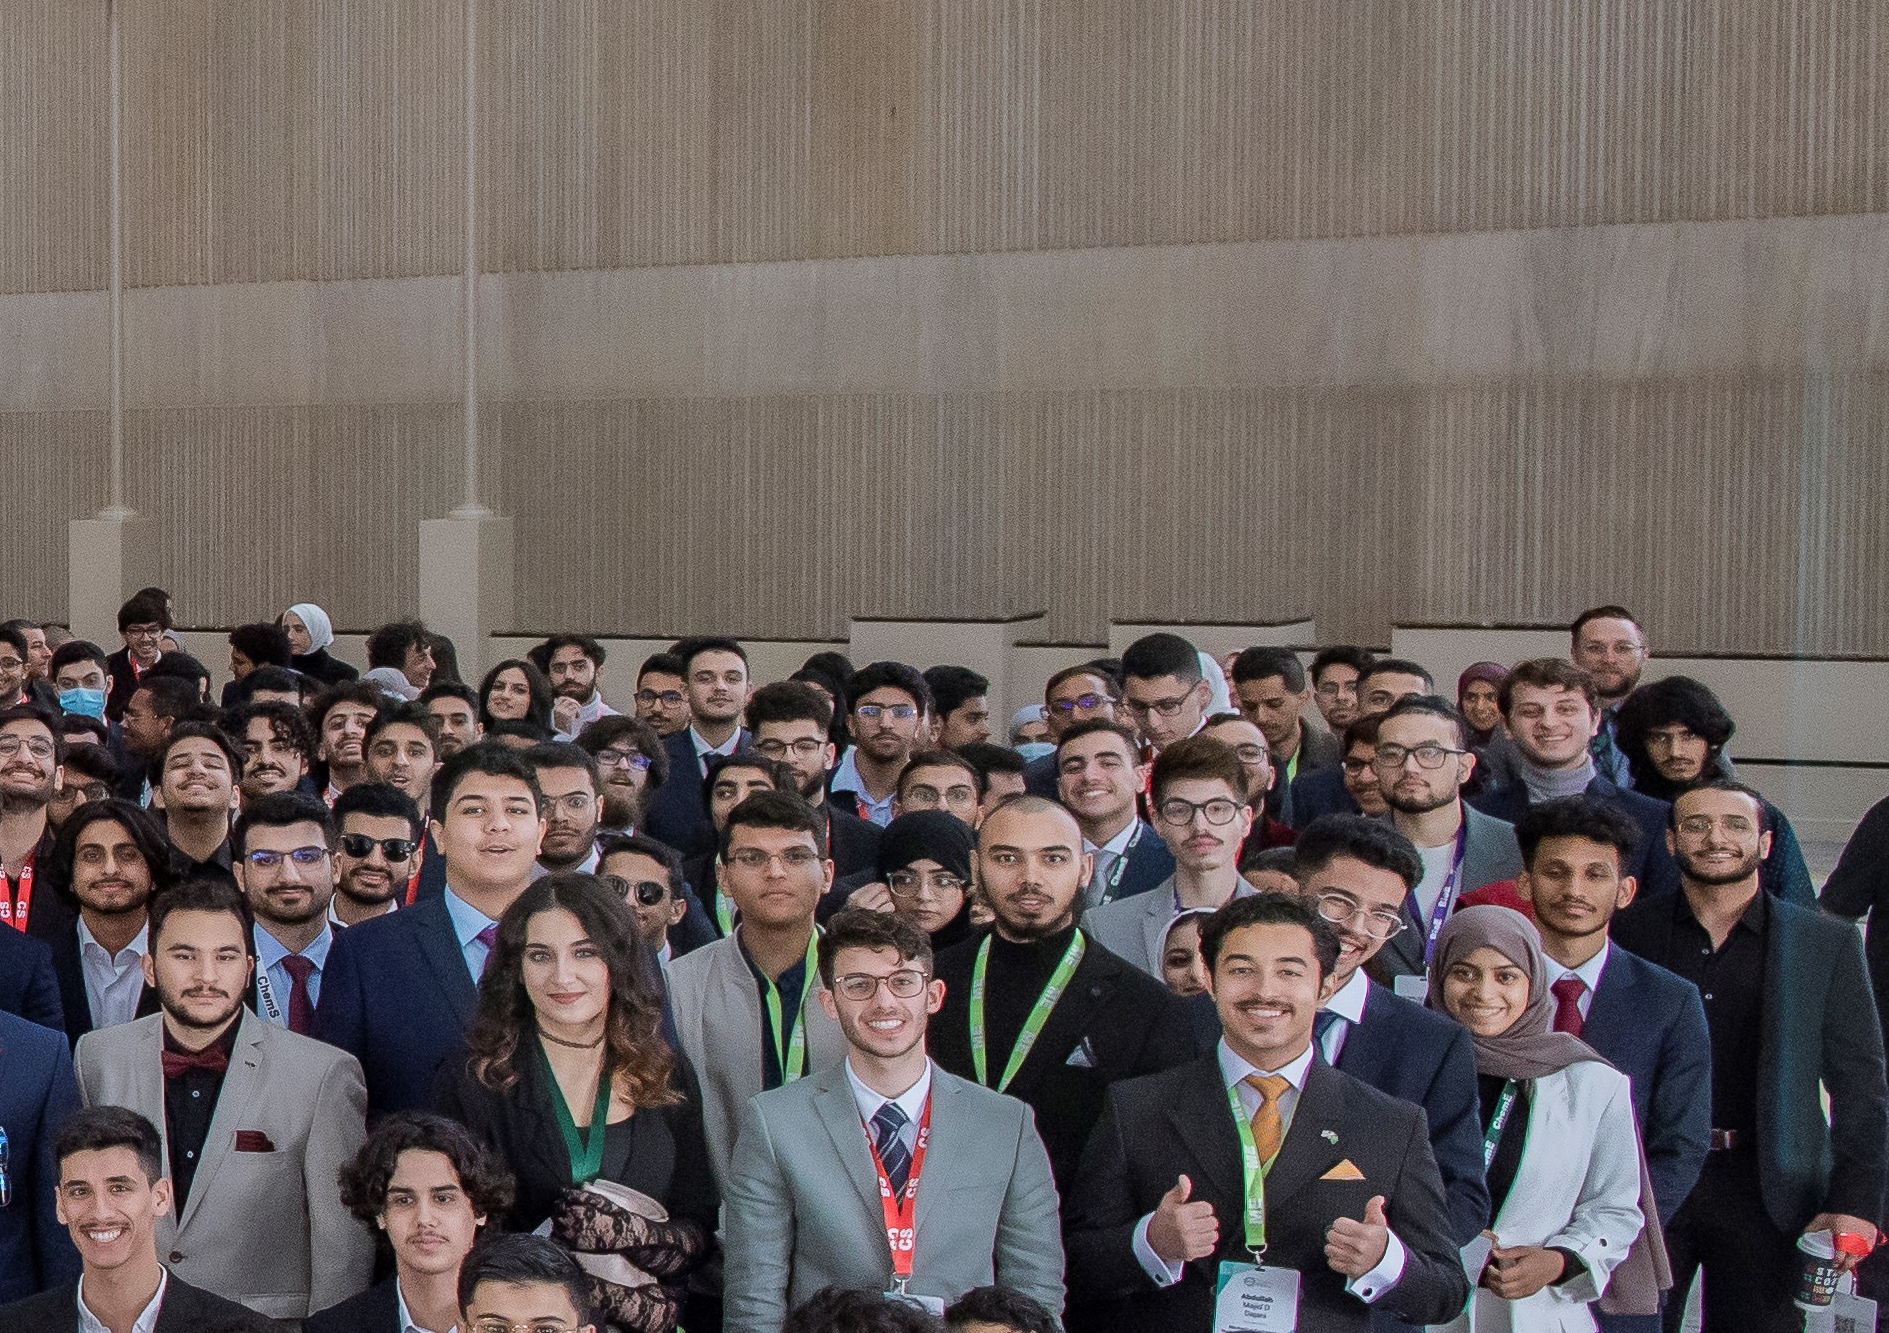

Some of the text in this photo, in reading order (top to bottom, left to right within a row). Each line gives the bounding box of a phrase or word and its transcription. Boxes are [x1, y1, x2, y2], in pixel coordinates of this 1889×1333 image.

[257, 975, 280, 1019] ChemS
[1248, 1198, 1264, 1226] ME
[898, 1228, 914, 1252] CS
[1241, 1293, 1274, 1303] Abdullah
